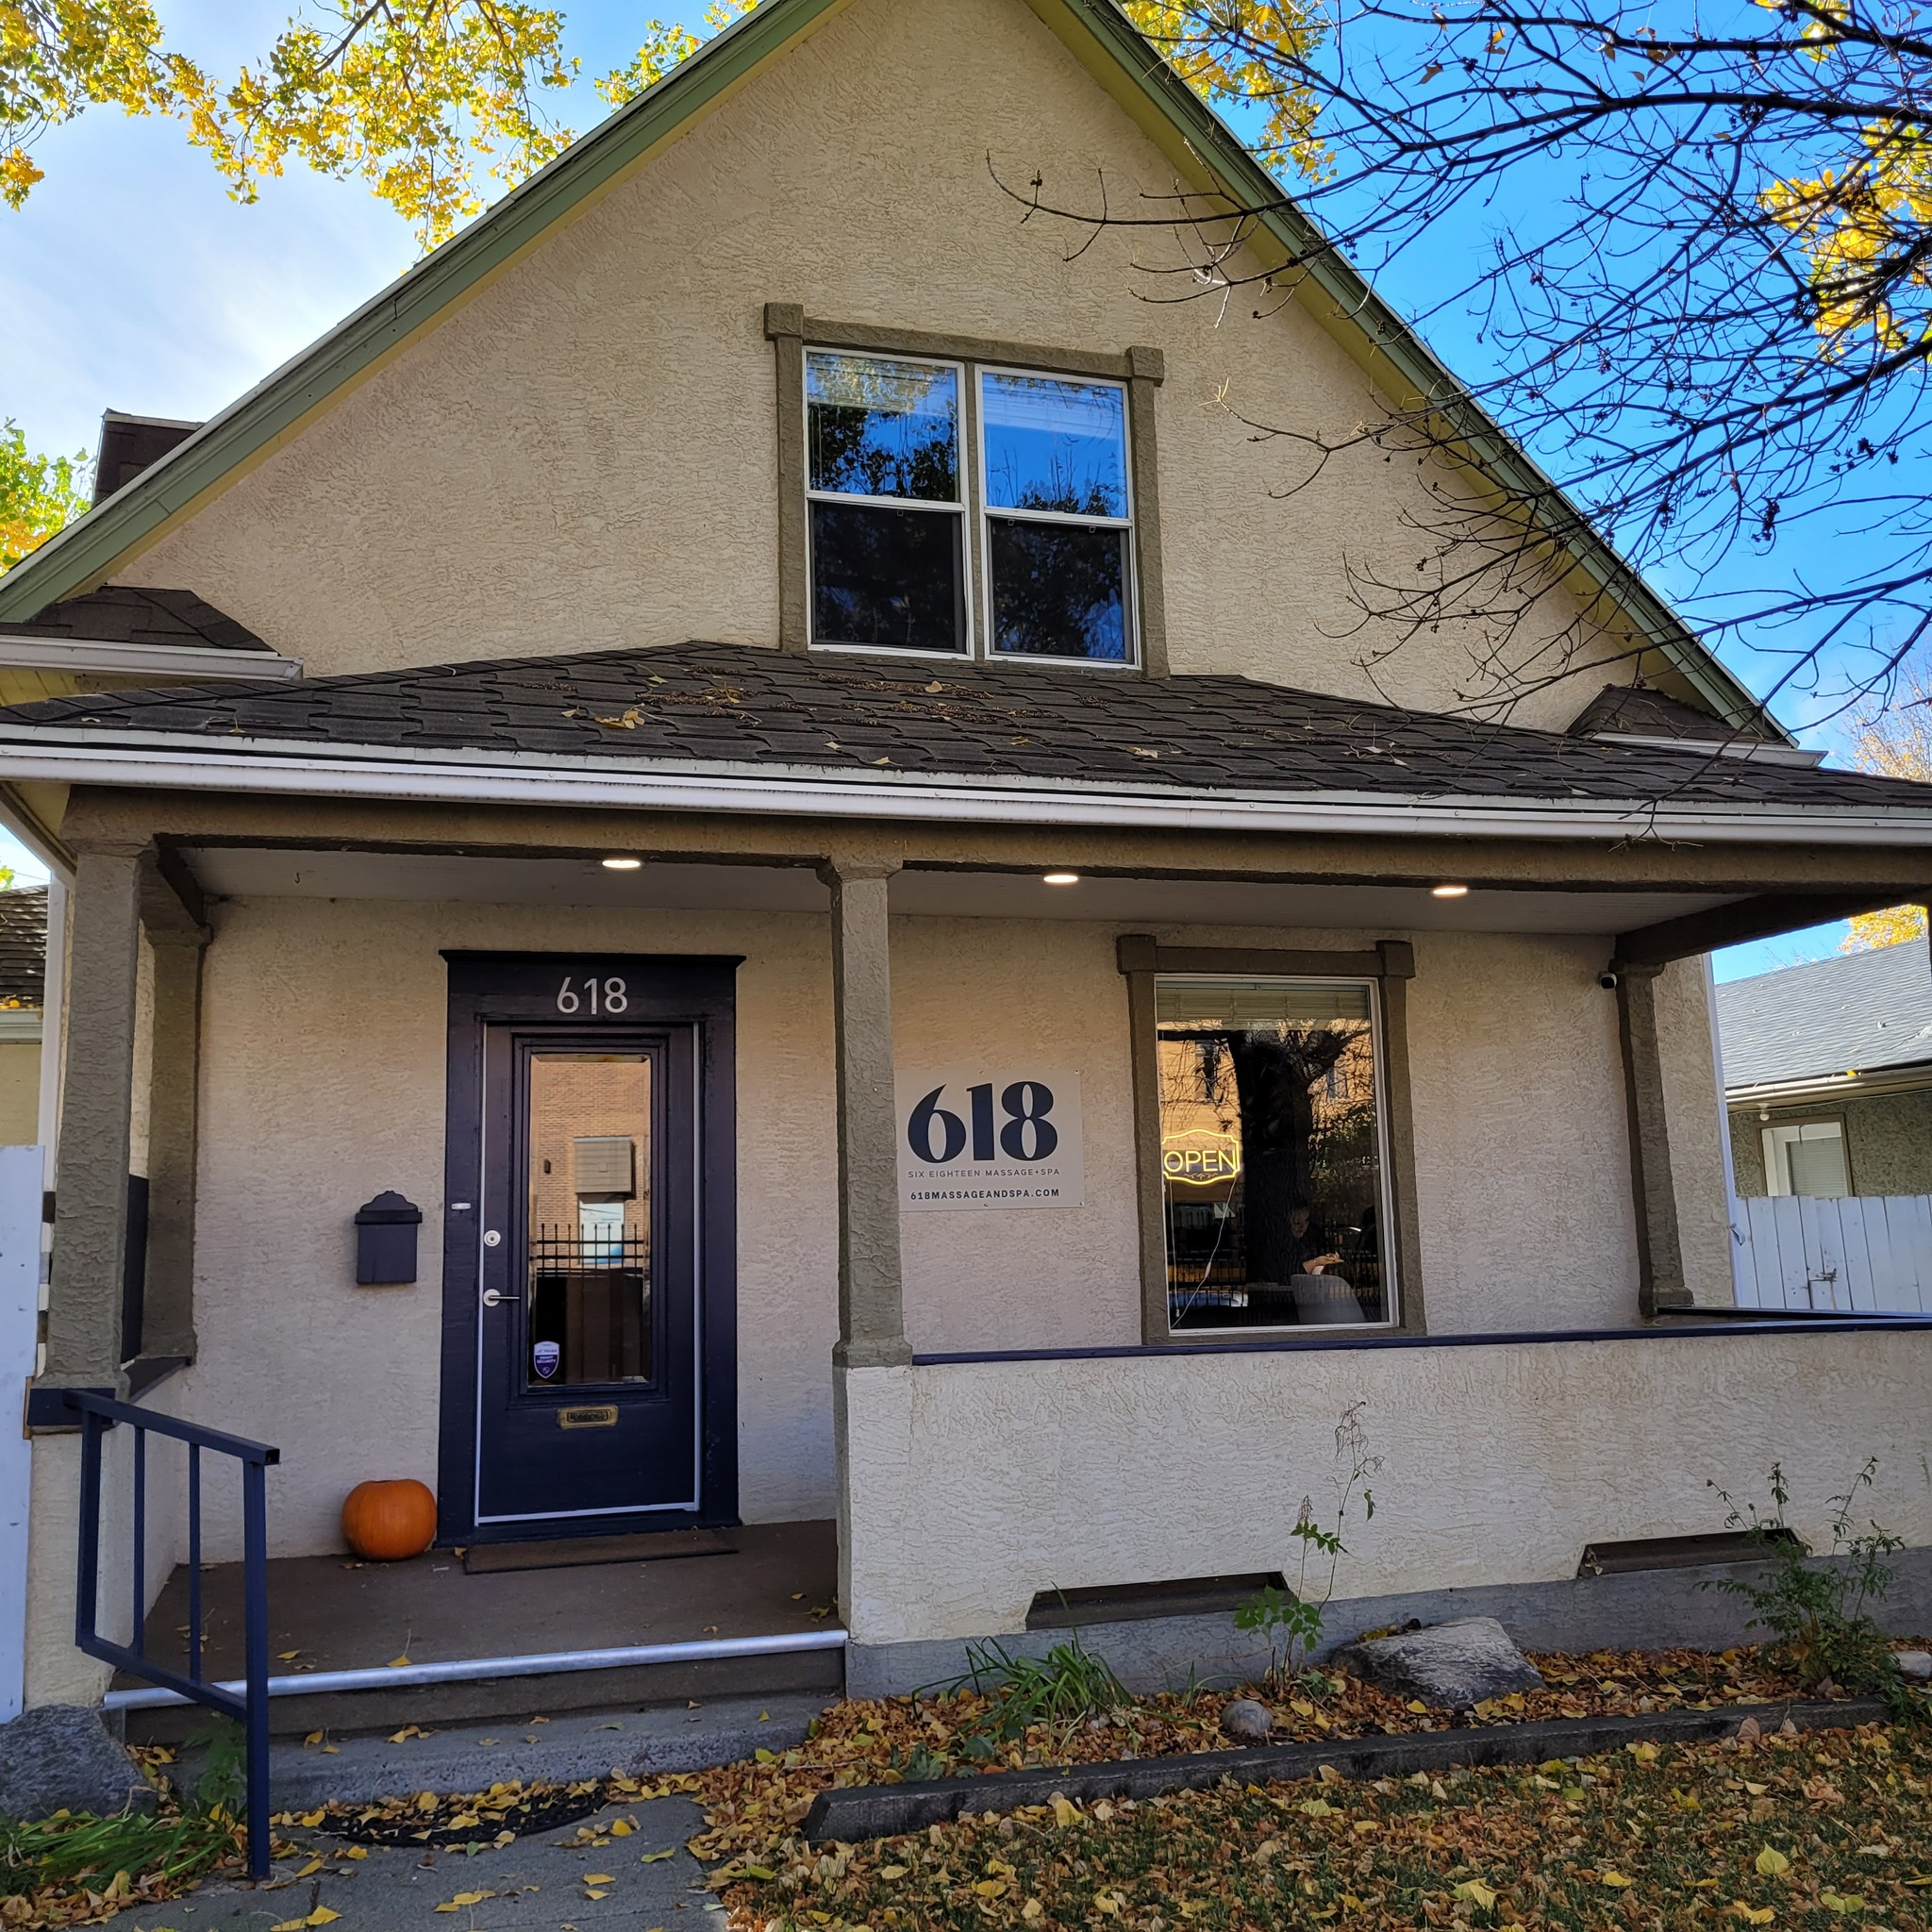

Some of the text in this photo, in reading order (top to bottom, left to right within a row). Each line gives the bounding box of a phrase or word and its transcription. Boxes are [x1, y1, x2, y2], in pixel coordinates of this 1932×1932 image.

[557, 976, 628, 1015] 618
[907, 1080, 1058, 1164] 618
[1163, 1149, 1238, 1173] OPEN
[908, 1170, 925, 1178] SIX
[928, 1169, 981, 1178] EIGHTEEN
[909, 1188, 1059, 1201] 618MASSAGEANDSPA.COM
